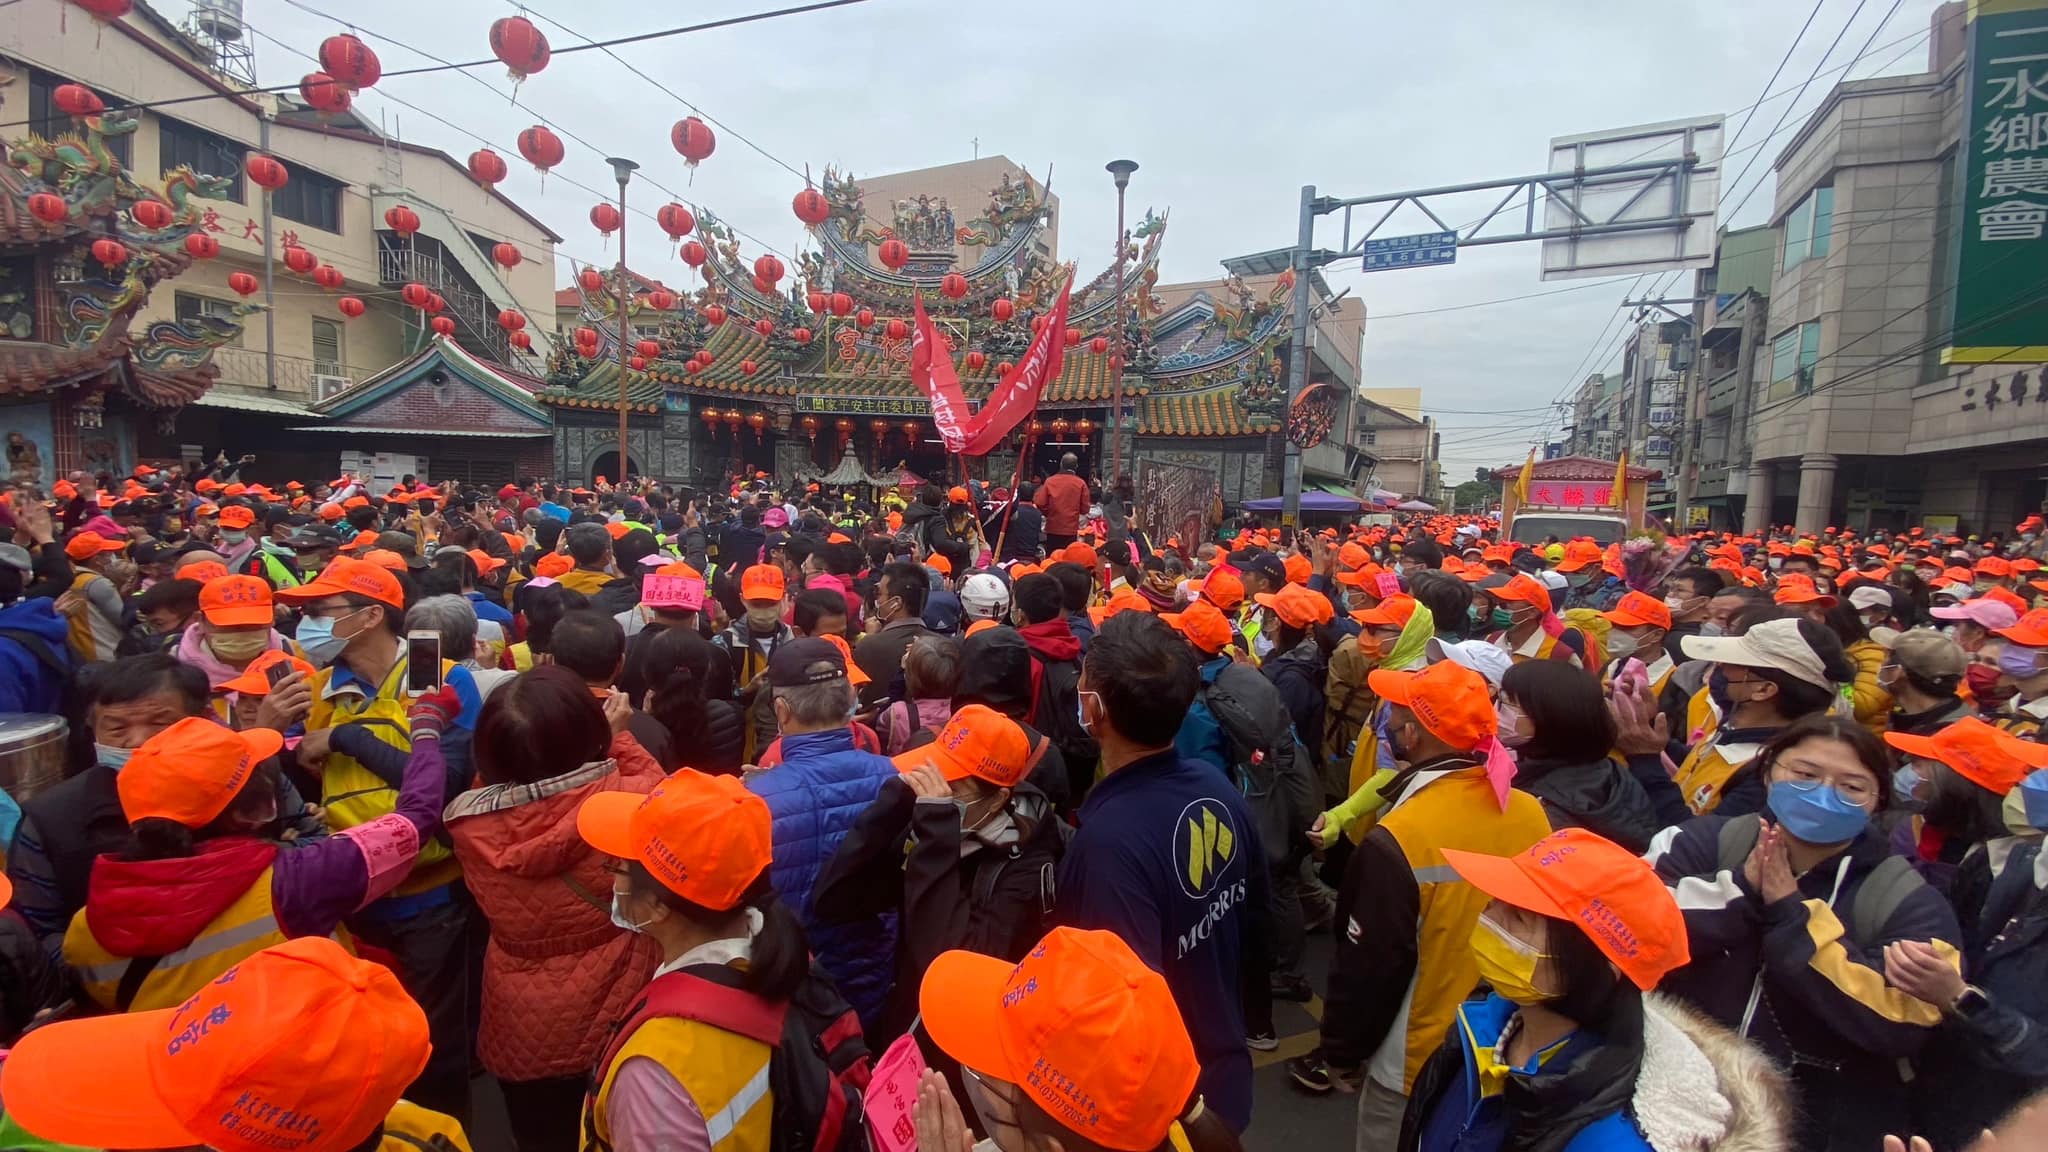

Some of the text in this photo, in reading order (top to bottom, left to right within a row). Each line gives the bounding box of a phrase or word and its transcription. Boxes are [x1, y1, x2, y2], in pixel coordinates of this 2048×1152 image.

[1976, 26, 2048, 241] 二水鄉農會
[1177, 878, 1247, 960] MORRIS
